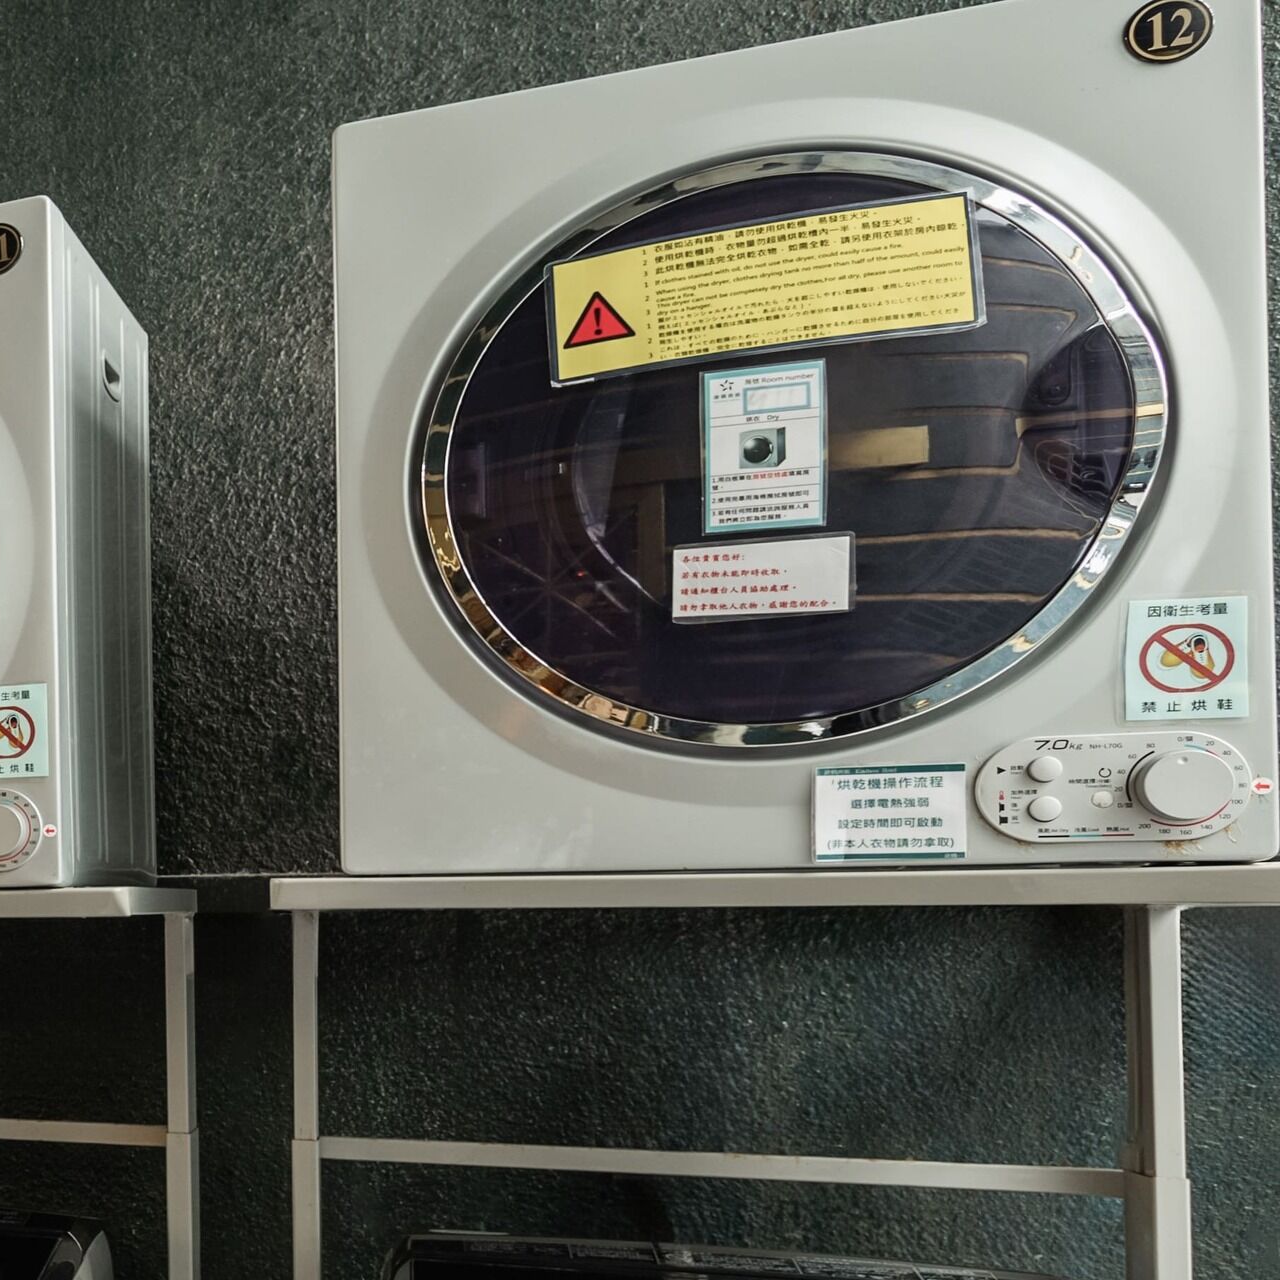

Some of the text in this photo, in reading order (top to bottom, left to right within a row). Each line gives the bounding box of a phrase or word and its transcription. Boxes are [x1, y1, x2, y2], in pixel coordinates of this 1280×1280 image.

[1146, 8, 1194, 51] 12
[786, 373, 814, 381] number
[1148, 603, 1228, 617] 因衛生考量
[1142, 699, 1232, 712] 禁止烘鞋
[1034, 740, 1083, 750] 7.0kg
[837, 776, 944, 790] 烘乾機操作流程
